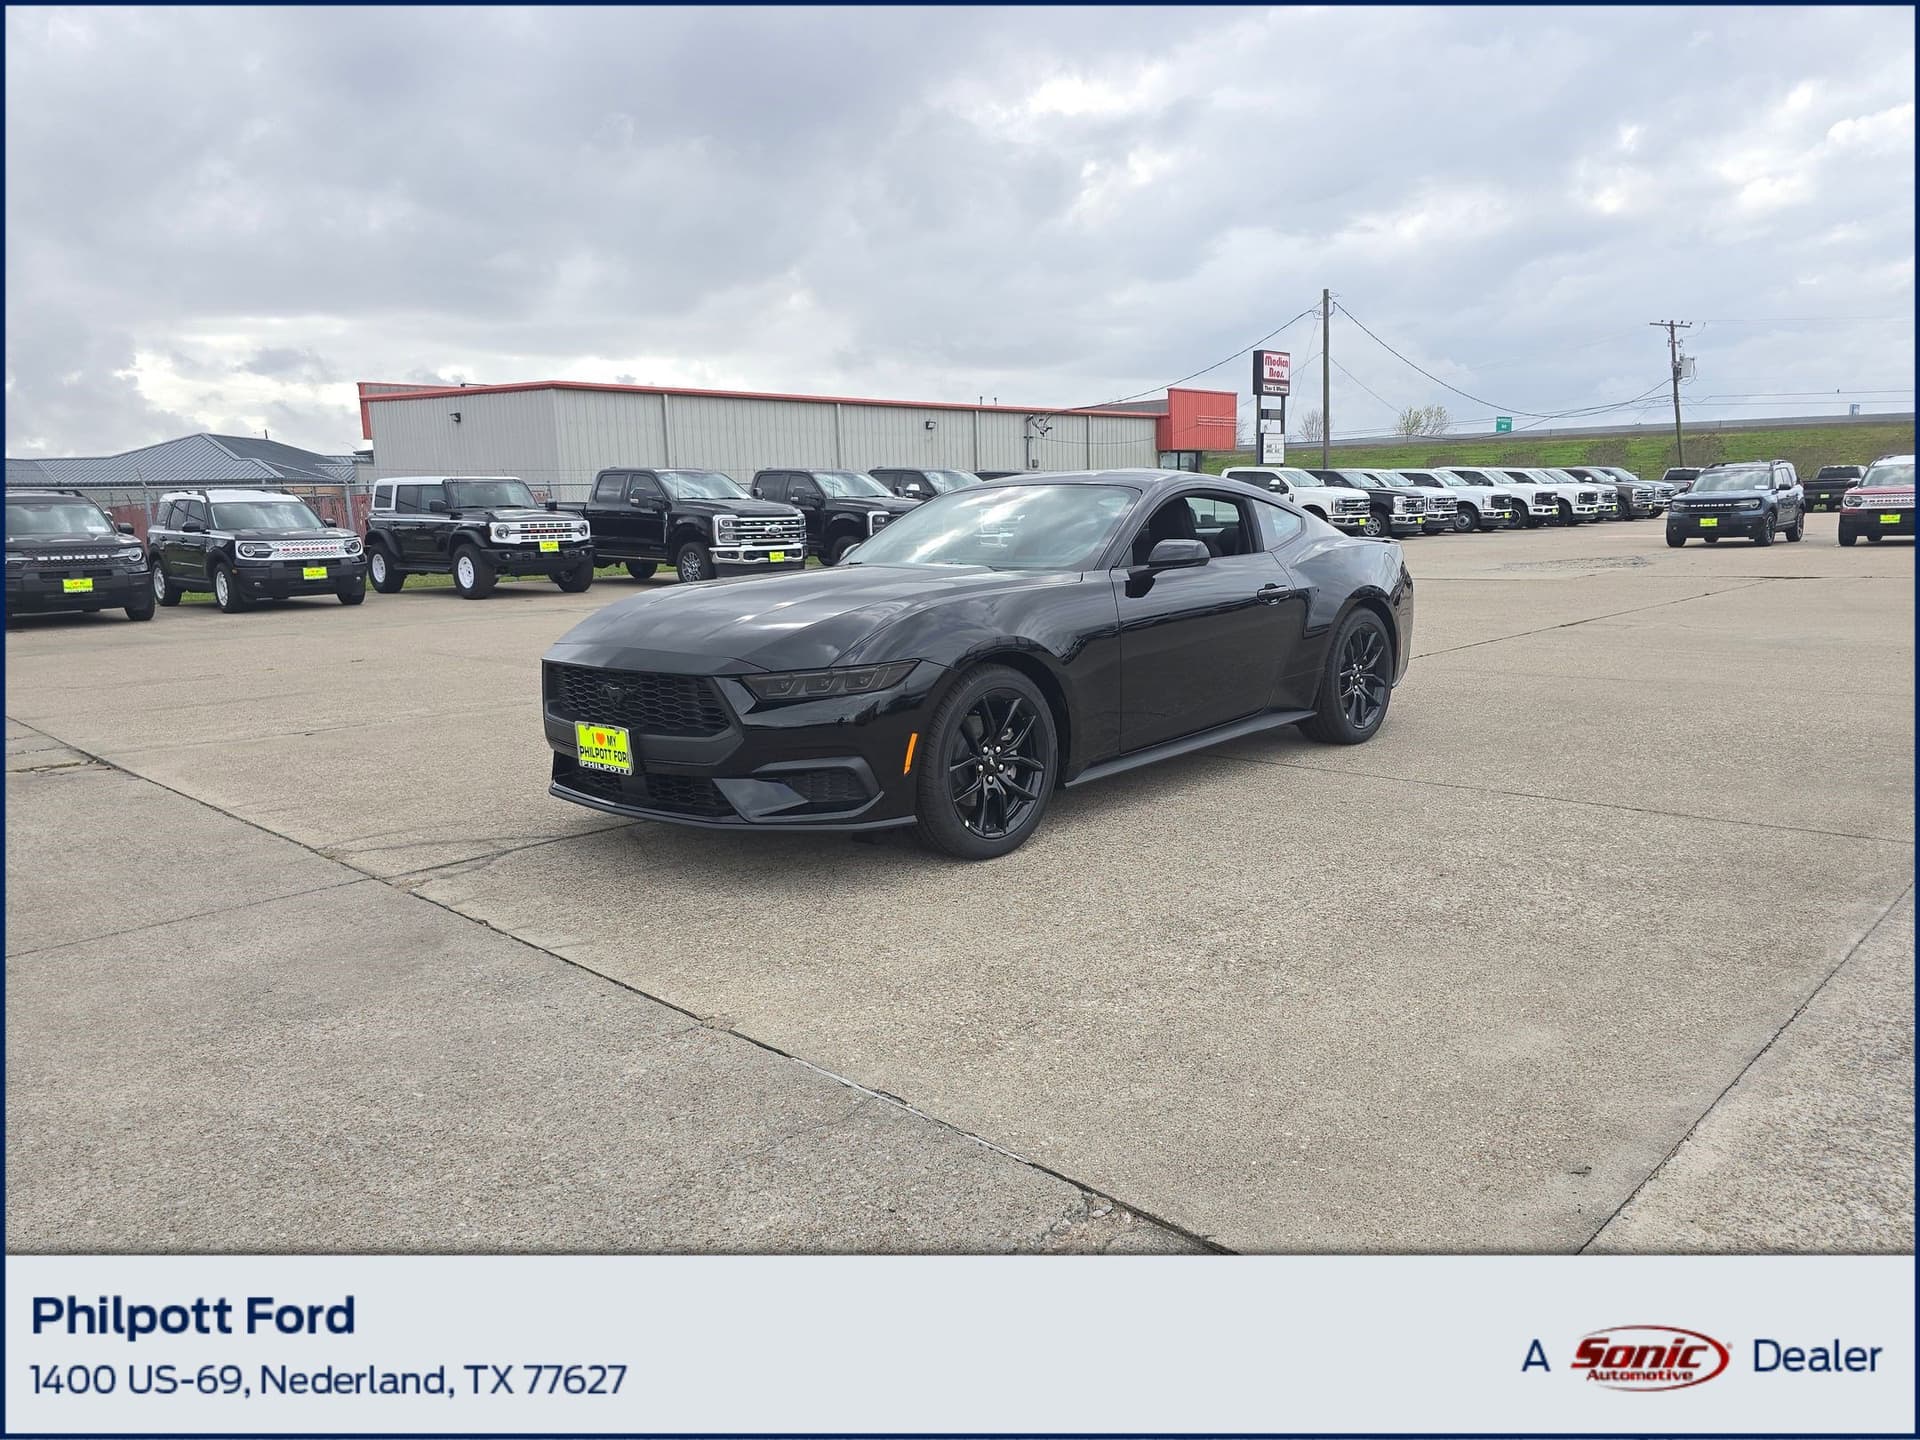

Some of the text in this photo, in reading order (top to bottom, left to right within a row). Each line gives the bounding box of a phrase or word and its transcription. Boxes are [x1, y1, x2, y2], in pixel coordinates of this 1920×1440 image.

[37, 554, 109, 562] BRONCO
[606, 735, 617, 748] MY
[579, 745, 612, 761] PHILPOTT
[582, 761, 629, 775] PHILPOTT
